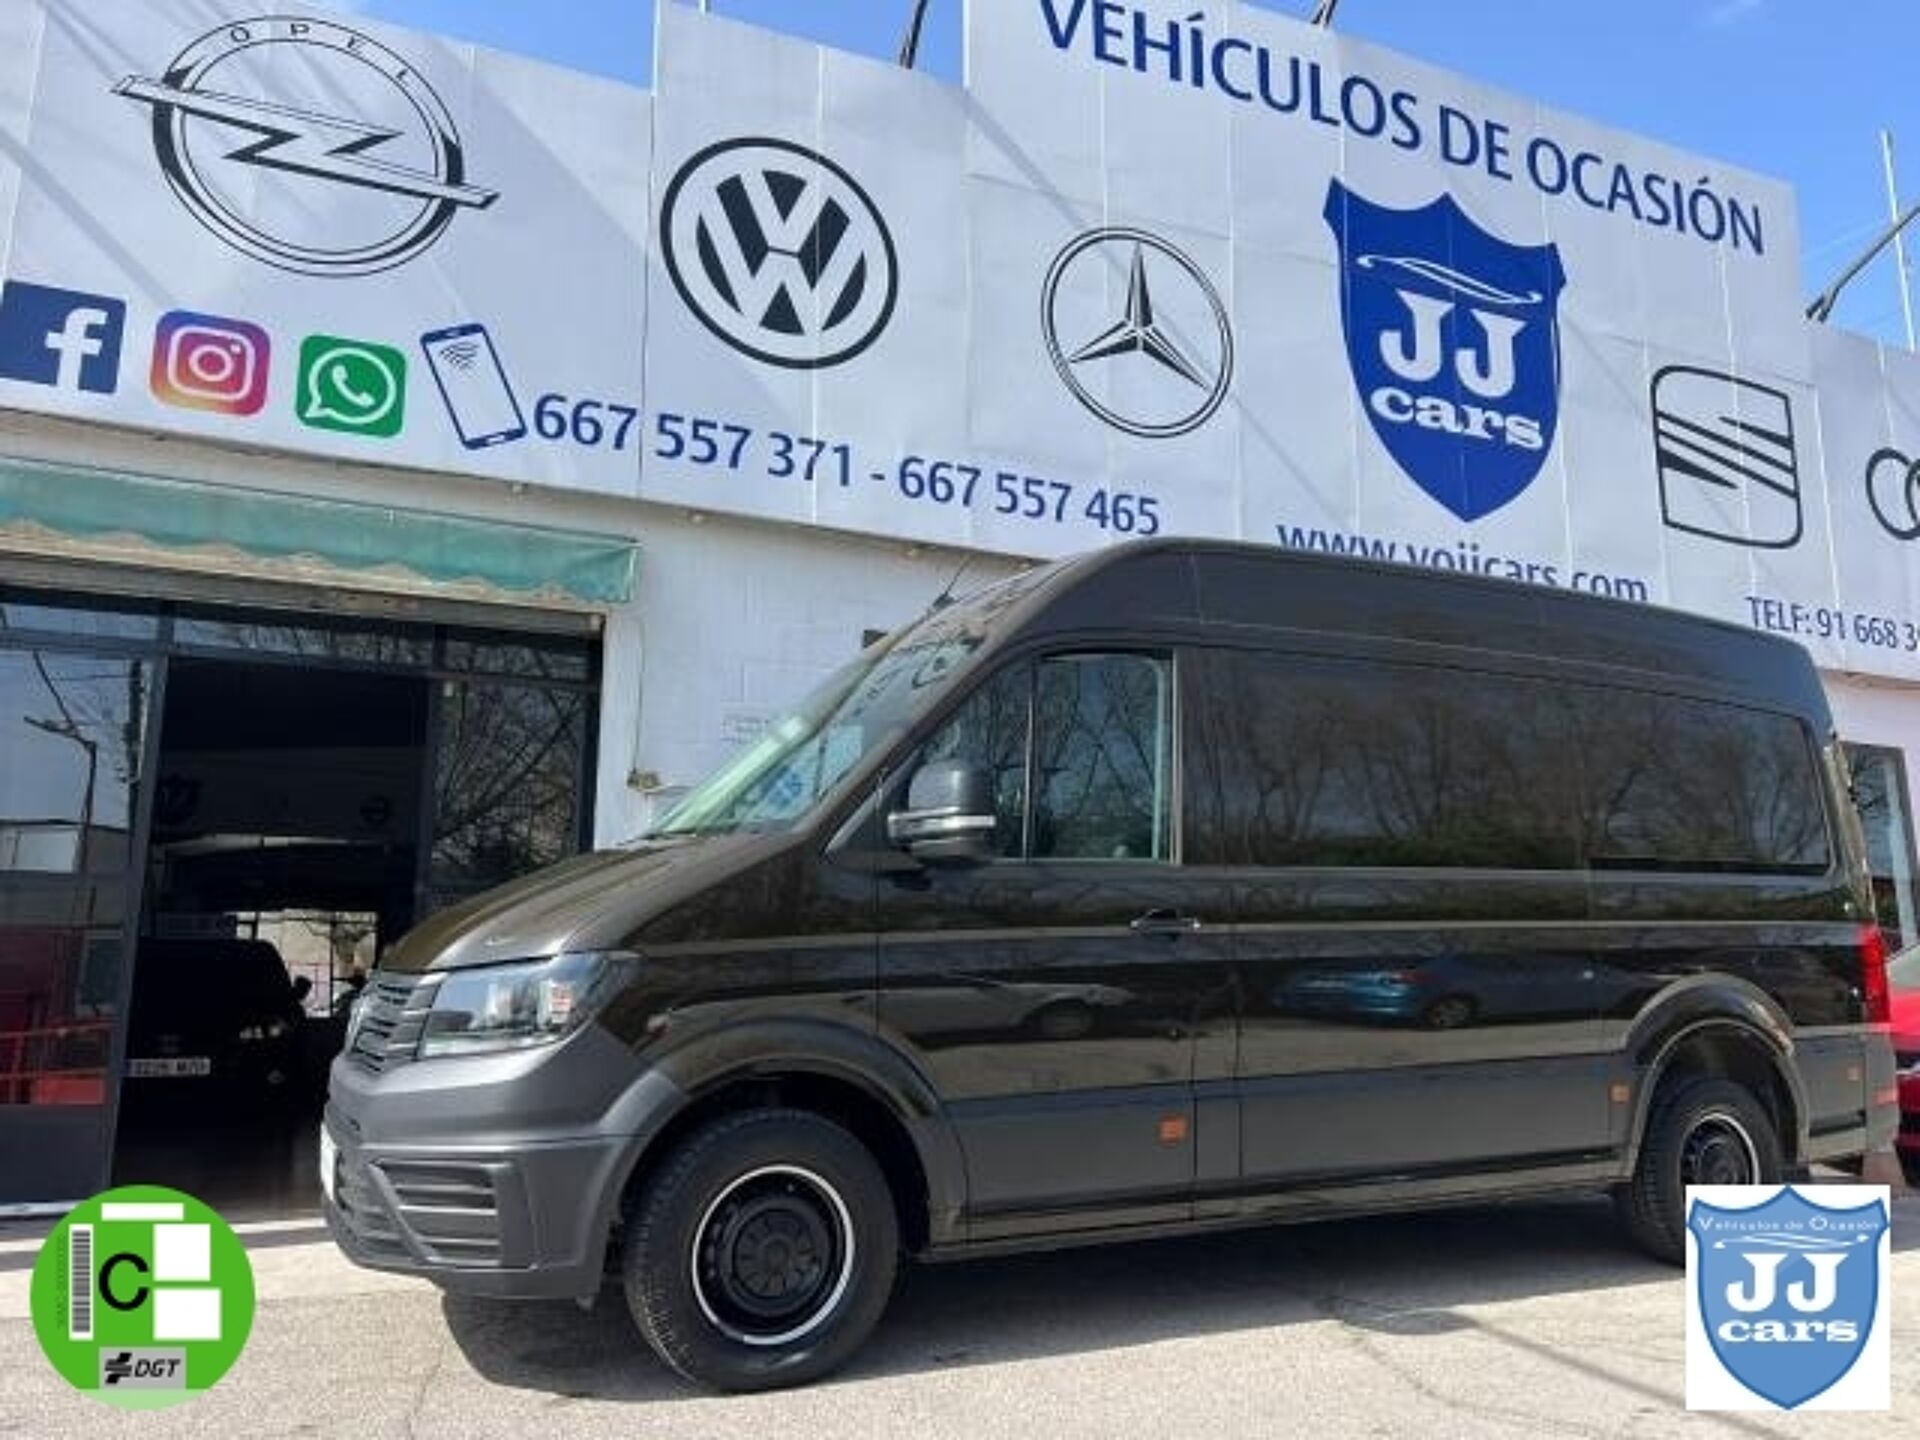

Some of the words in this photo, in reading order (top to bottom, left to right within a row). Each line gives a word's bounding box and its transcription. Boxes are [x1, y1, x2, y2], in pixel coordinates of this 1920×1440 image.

[230, 23, 414, 88] OPEL
[1040, 0, 1420, 150] VEHÍCULOS
[1440, 106, 1512, 183] DE
[1527, 138, 1765, 257] OCASIÓN
[1379, 288, 1528, 397] JJ
[1370, 387, 1544, 450] cars
[534, 394, 637, 451] 667
[656, 413, 751, 469] 557
[768, 431, 852, 487] 371
[899, 457, 981, 507] 667
[996, 472, 1072, 522] 557
[1085, 488, 1160, 536] 465
[1745, 597, 1811, 634] TELF:
[1817, 608, 1846, 639] 91
[1854, 614, 1899, 648] 668
[1901, 622, 1920, 652] 3
